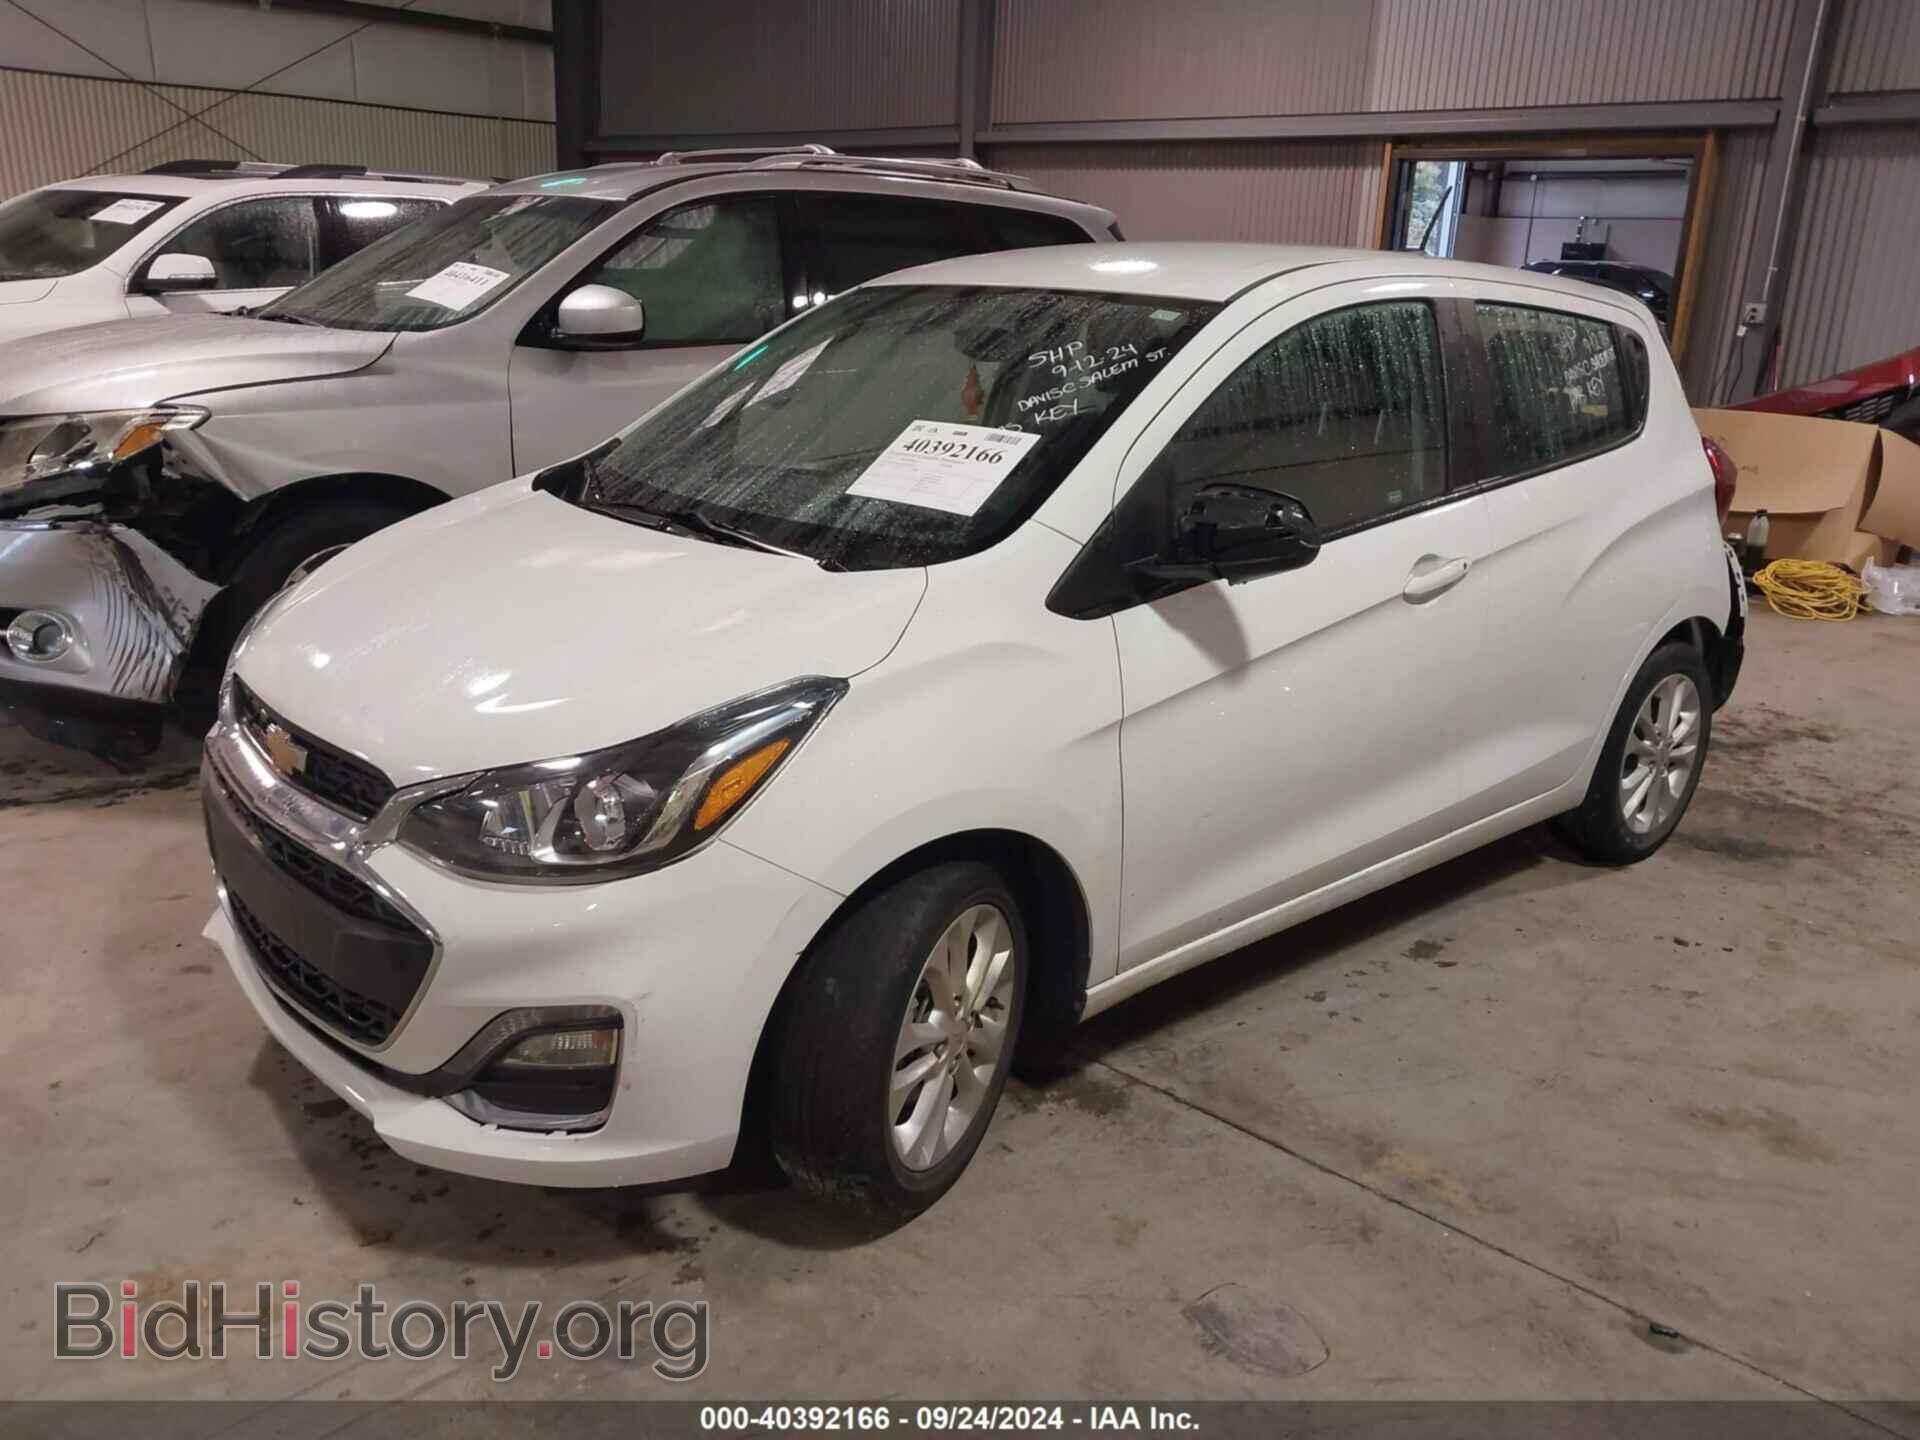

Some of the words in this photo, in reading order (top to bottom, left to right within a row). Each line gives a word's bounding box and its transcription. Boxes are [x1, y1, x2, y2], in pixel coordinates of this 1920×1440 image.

[1028, 341, 1083, 368] SHP
[1034, 398, 1088, 424] KEY
[903, 438, 1006, 465] 40392166
